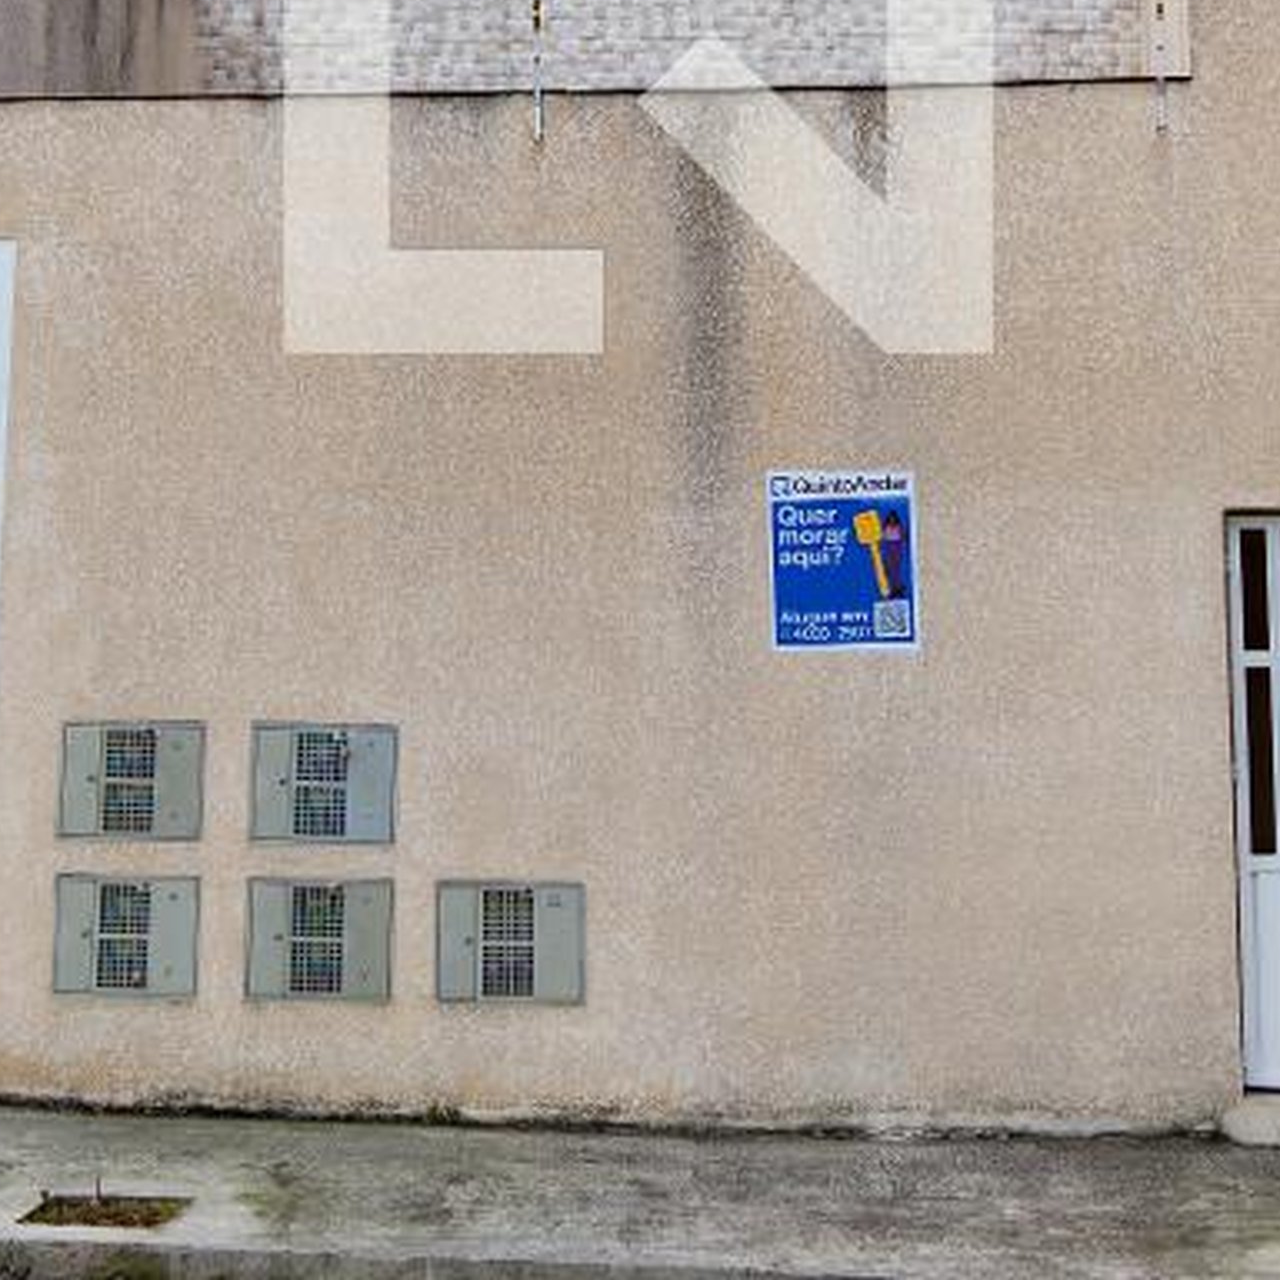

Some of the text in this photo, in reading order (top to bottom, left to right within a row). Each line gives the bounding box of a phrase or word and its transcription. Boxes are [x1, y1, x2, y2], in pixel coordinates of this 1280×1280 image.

[778, 506, 837, 527] Quer
[780, 528, 848, 545] morar
[780, 546, 845, 569] aqui?
